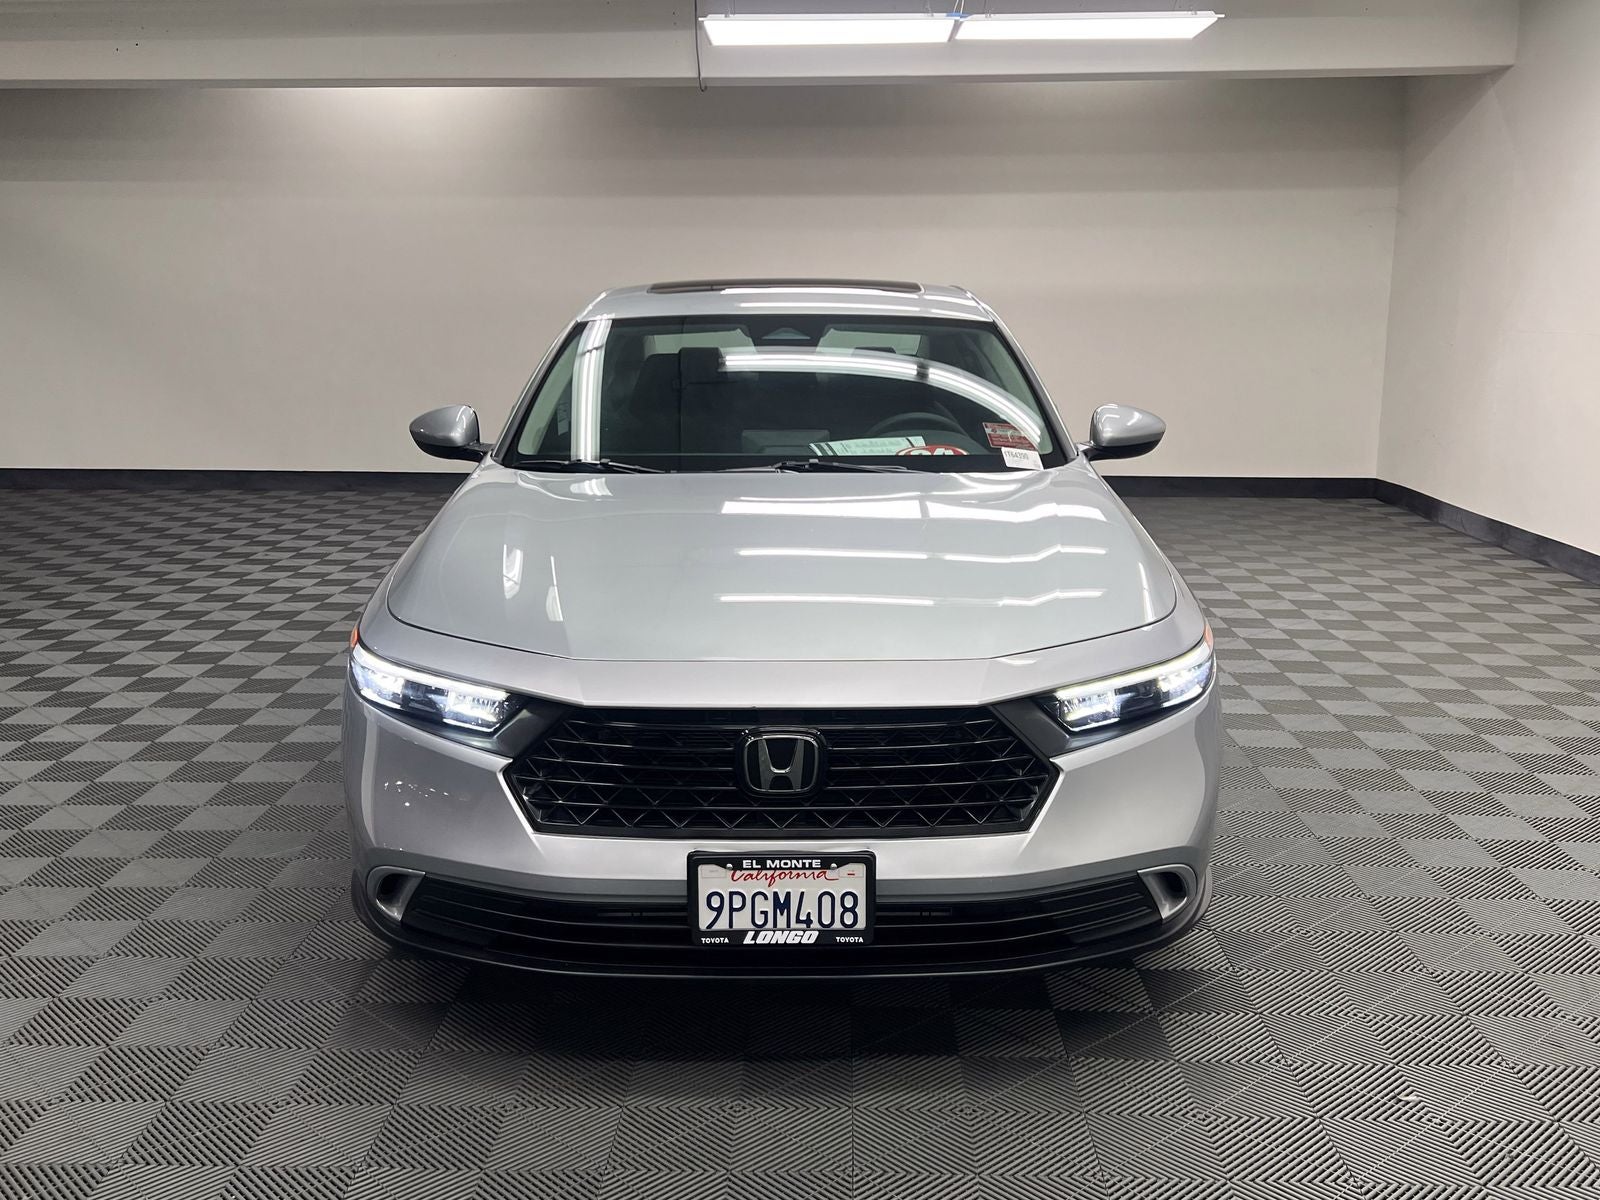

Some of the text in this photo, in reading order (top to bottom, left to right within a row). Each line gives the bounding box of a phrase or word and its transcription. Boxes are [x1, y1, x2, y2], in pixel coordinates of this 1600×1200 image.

[742, 859, 822, 869] EL MONTE
[705, 890, 859, 930] 9PGM408
[701, 936, 730, 944] TOYOTA
[742, 930, 819, 945] LONGO
[835, 935, 864, 943] TOYOTA
